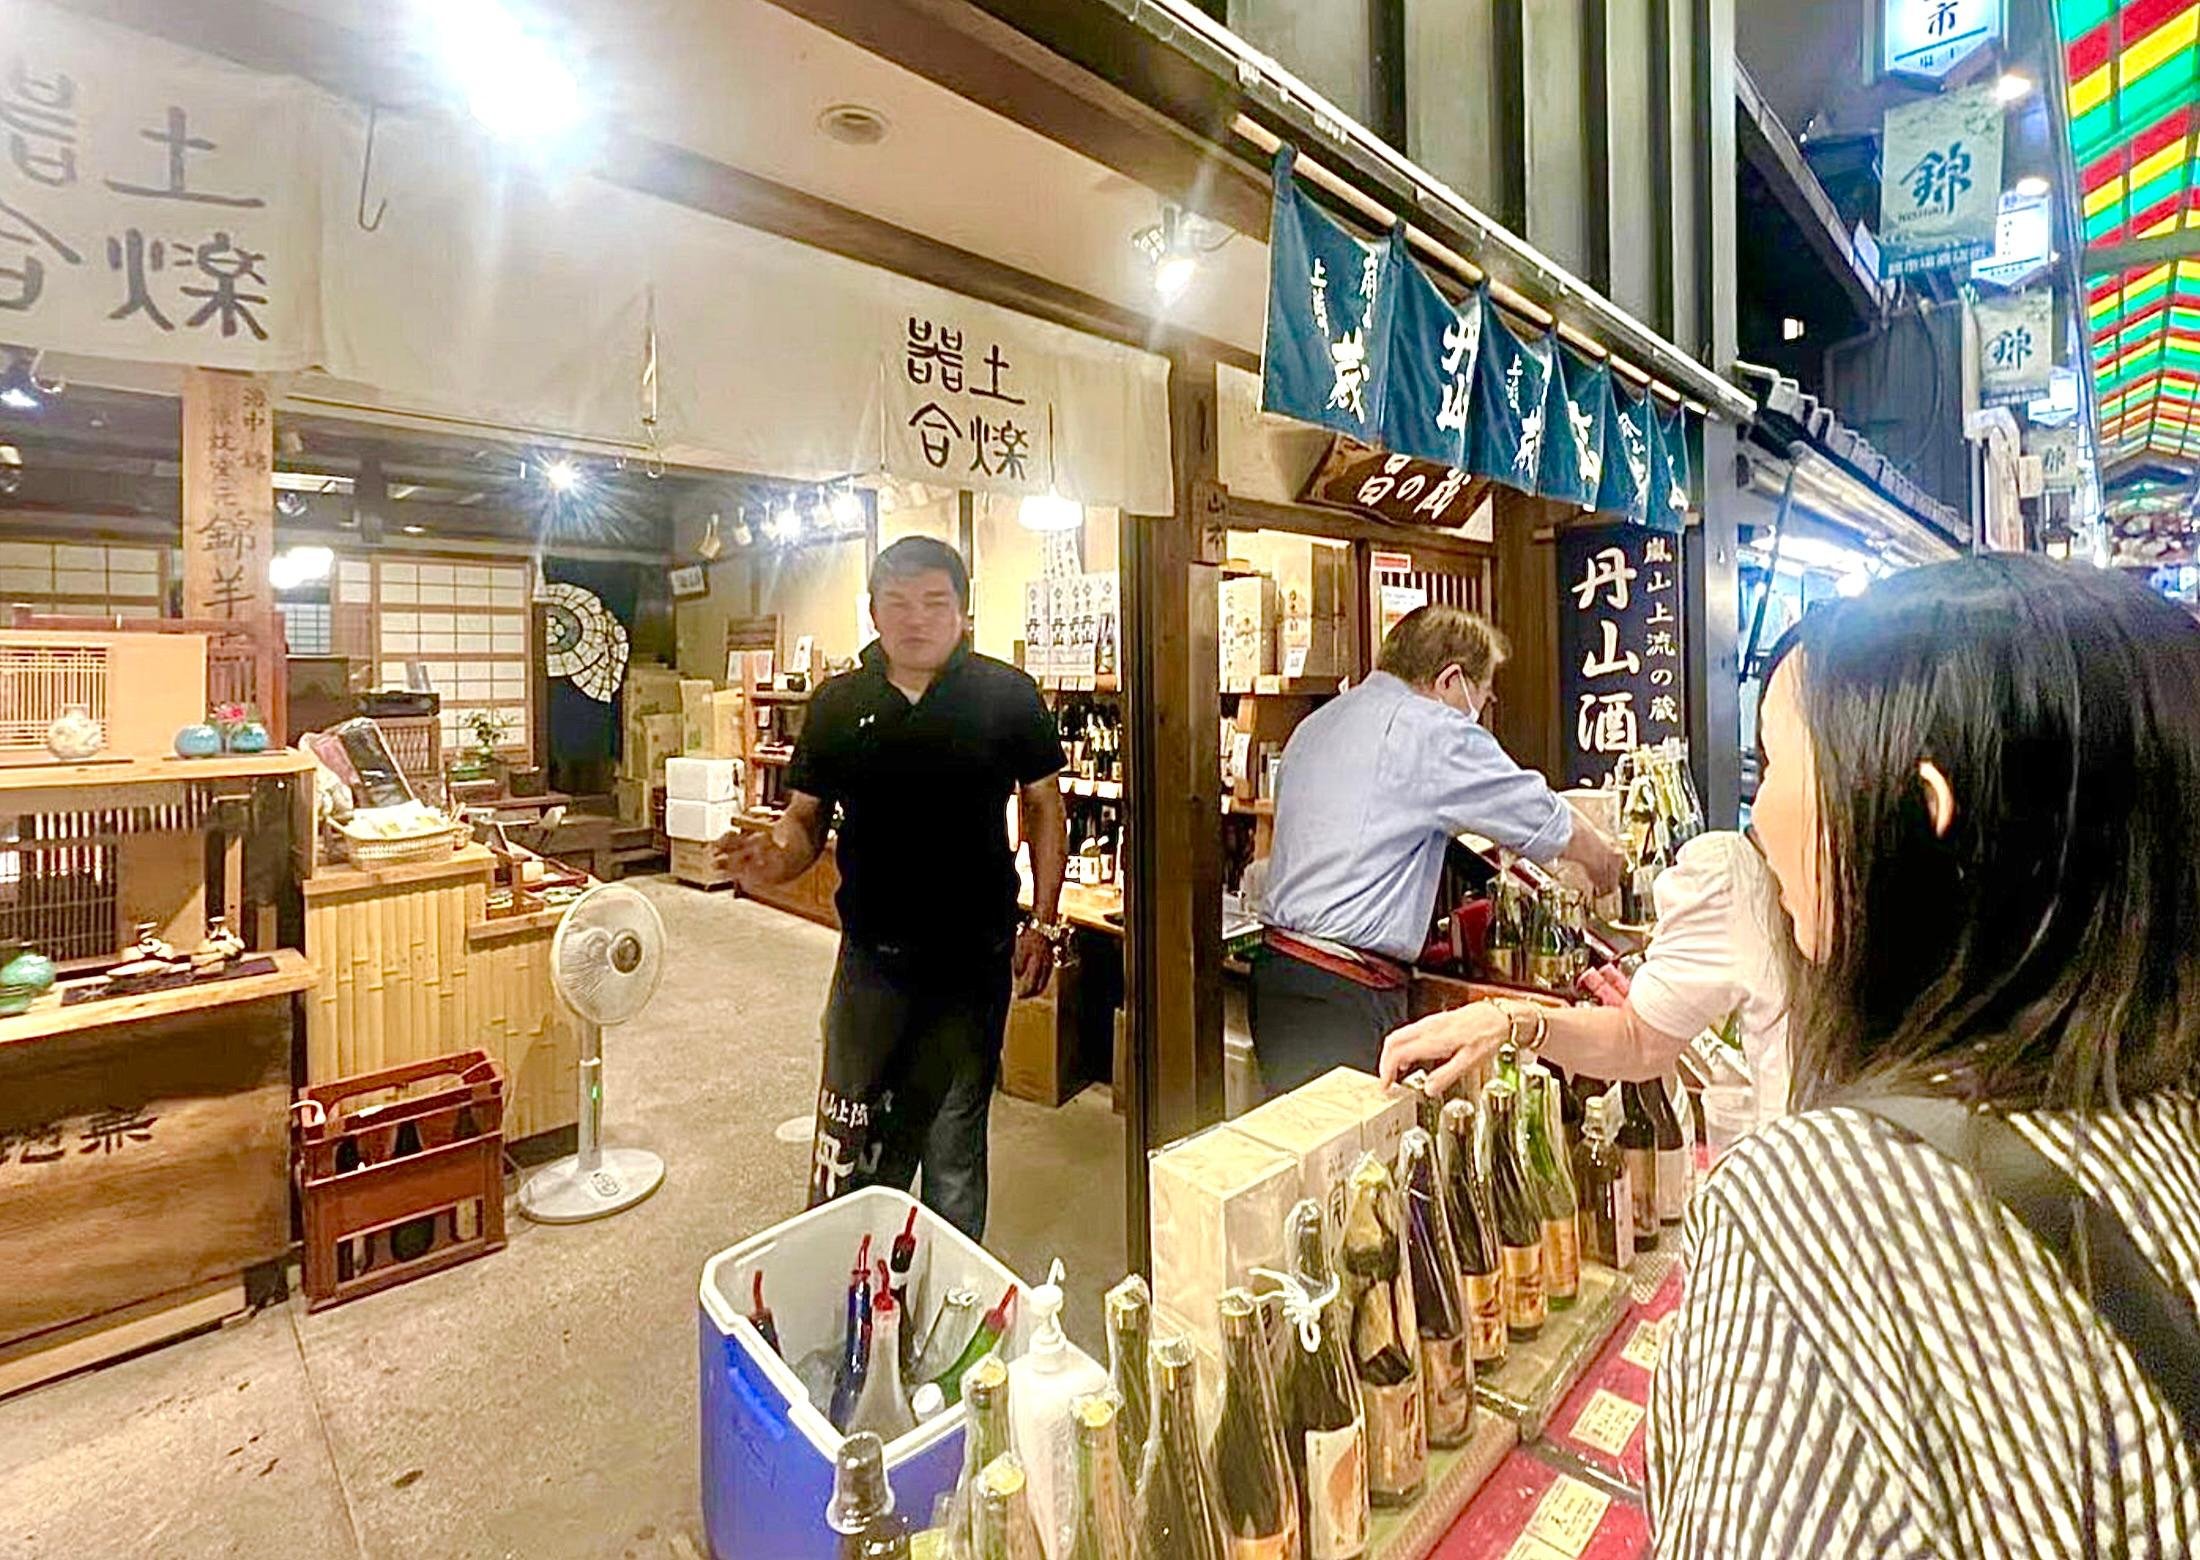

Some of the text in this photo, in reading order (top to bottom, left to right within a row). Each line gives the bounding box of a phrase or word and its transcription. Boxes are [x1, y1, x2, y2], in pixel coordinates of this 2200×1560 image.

[1898, 140, 1973, 217] 錦
[1571, 546, 1642, 788] 丹山酒
[1643, 536, 1678, 724] 嵐山上流の蔵
